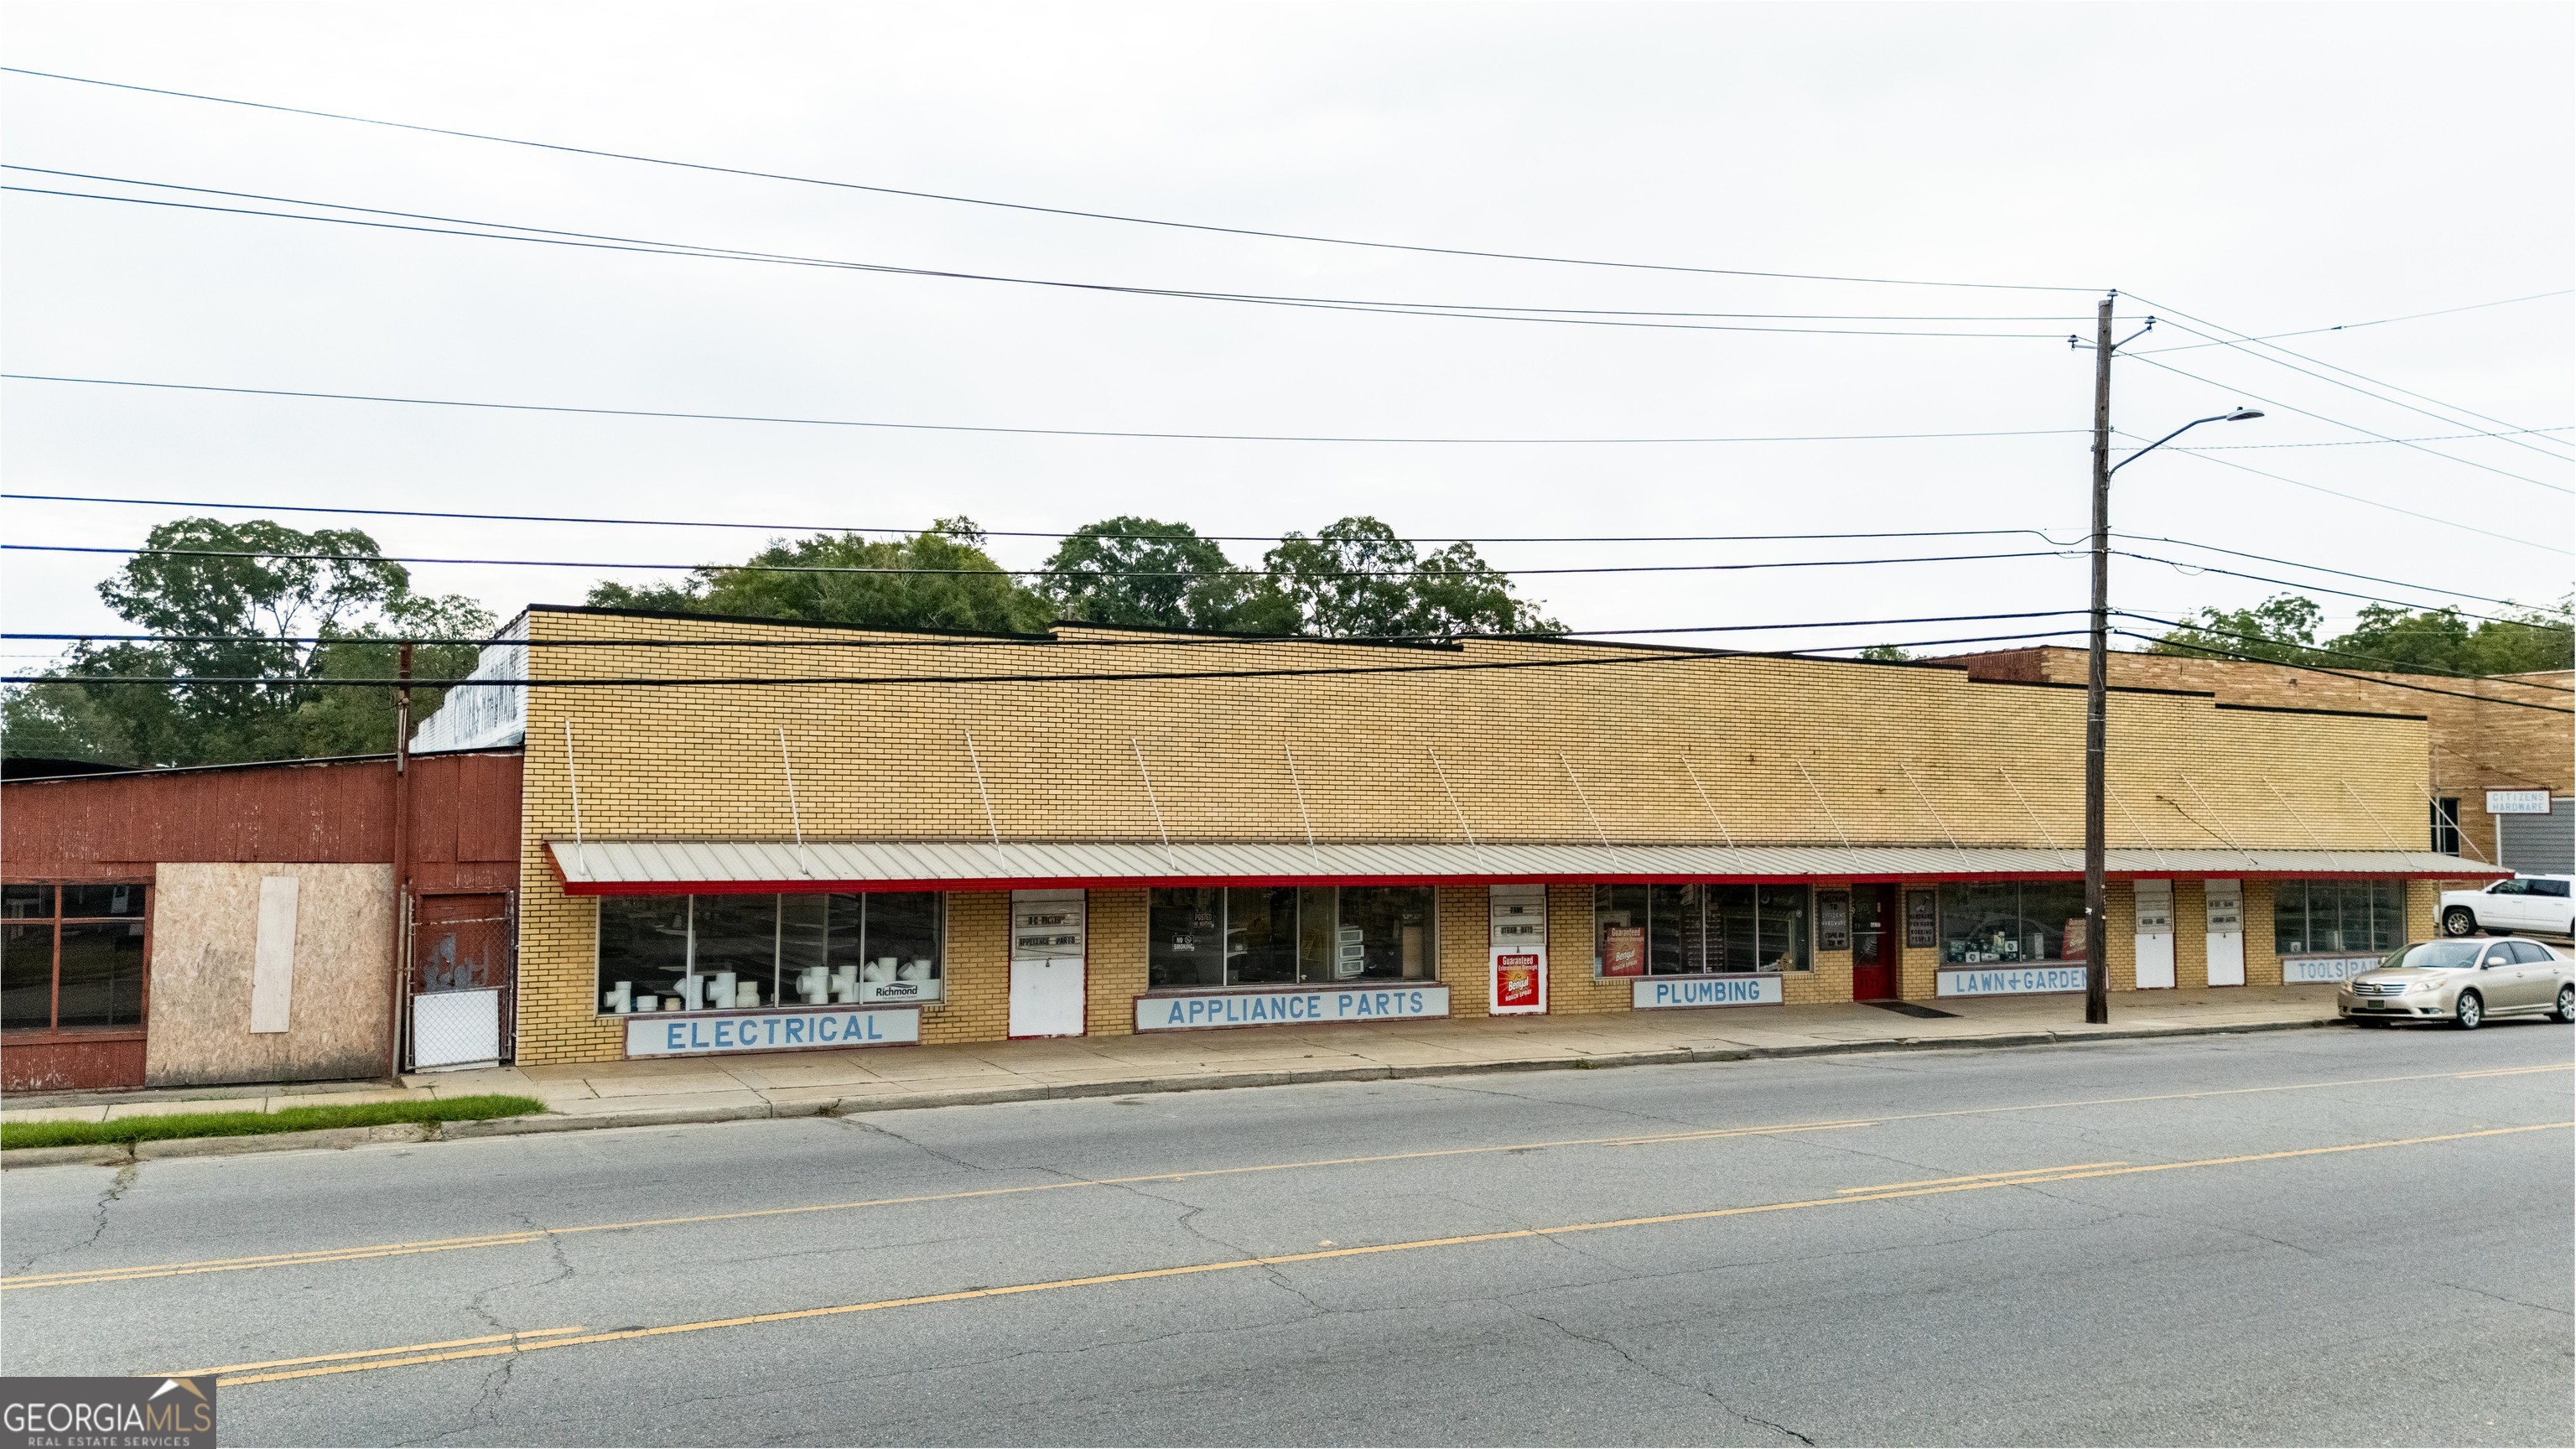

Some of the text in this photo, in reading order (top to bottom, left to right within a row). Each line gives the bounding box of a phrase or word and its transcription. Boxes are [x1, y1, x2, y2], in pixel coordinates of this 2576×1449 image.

[1611, 927, 1641, 937] Guaranteed
[1018, 936, 1076, 947] APPLIANCE PARTS
[1503, 956, 1534, 965] Guaranteed
[1615, 948, 1636, 962] Bengal
[2298, 962, 2344, 979] TOOLS
[875, 985, 918, 996] Richmond
[1509, 975, 1530, 992] Bengal
[1956, 972, 2005, 993] LAWN
[1657, 980, 1760, 1005] PLUMBING
[1168, 991, 1424, 1025] APPLIANCE PARTS
[667, 1015, 883, 1050] ELECTRICAL
